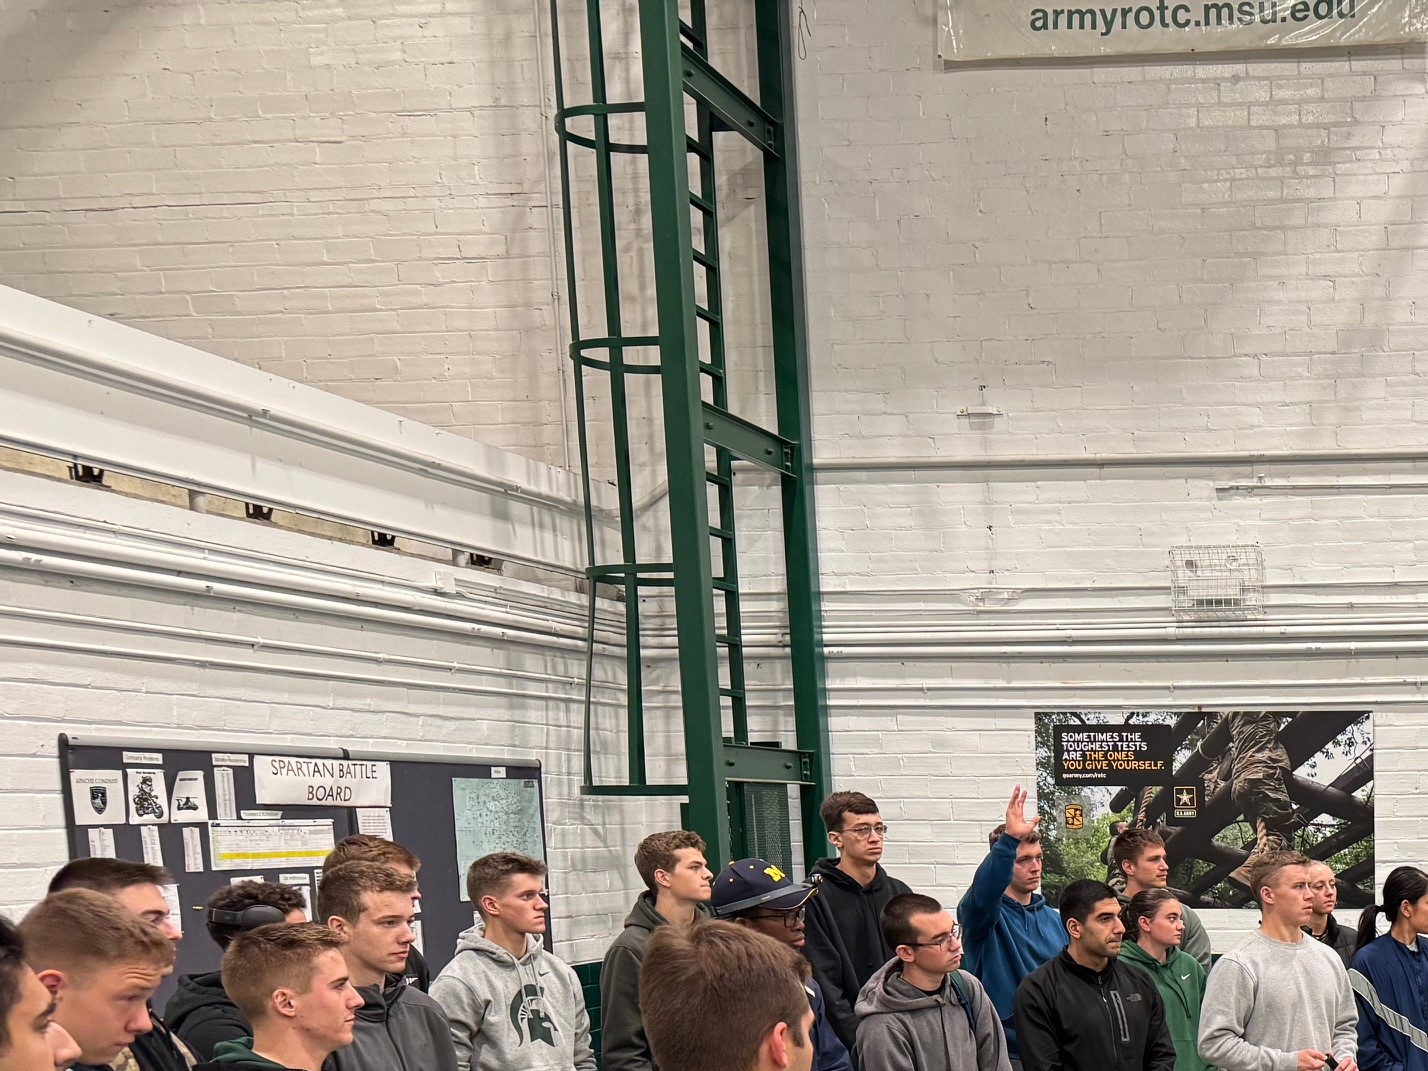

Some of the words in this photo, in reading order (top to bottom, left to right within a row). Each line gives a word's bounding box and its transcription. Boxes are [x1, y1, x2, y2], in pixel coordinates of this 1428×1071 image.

[1029, 0, 1357, 37] armyrotc.msu.edu
[1061, 732, 1119, 742] SOMETIMES
[1121, 732, 1142, 742] THE
[1062, 741, 1116, 751] TOUGHEST
[1117, 741, 1148, 751] TESTS
[1062, 751, 1083, 760] ARE
[1085, 751, 1105, 760] THE
[1107, 751, 1135, 760] ONES
[270, 758, 335, 779] SPARTAN
[338, 762, 378, 780] BATTLE
[1062, 760, 1083, 770] YOU
[1085, 760, 1109, 770] GIVE
[1111, 760, 1165, 770] YOURSELF.
[306, 785, 352, 802] BOARD
